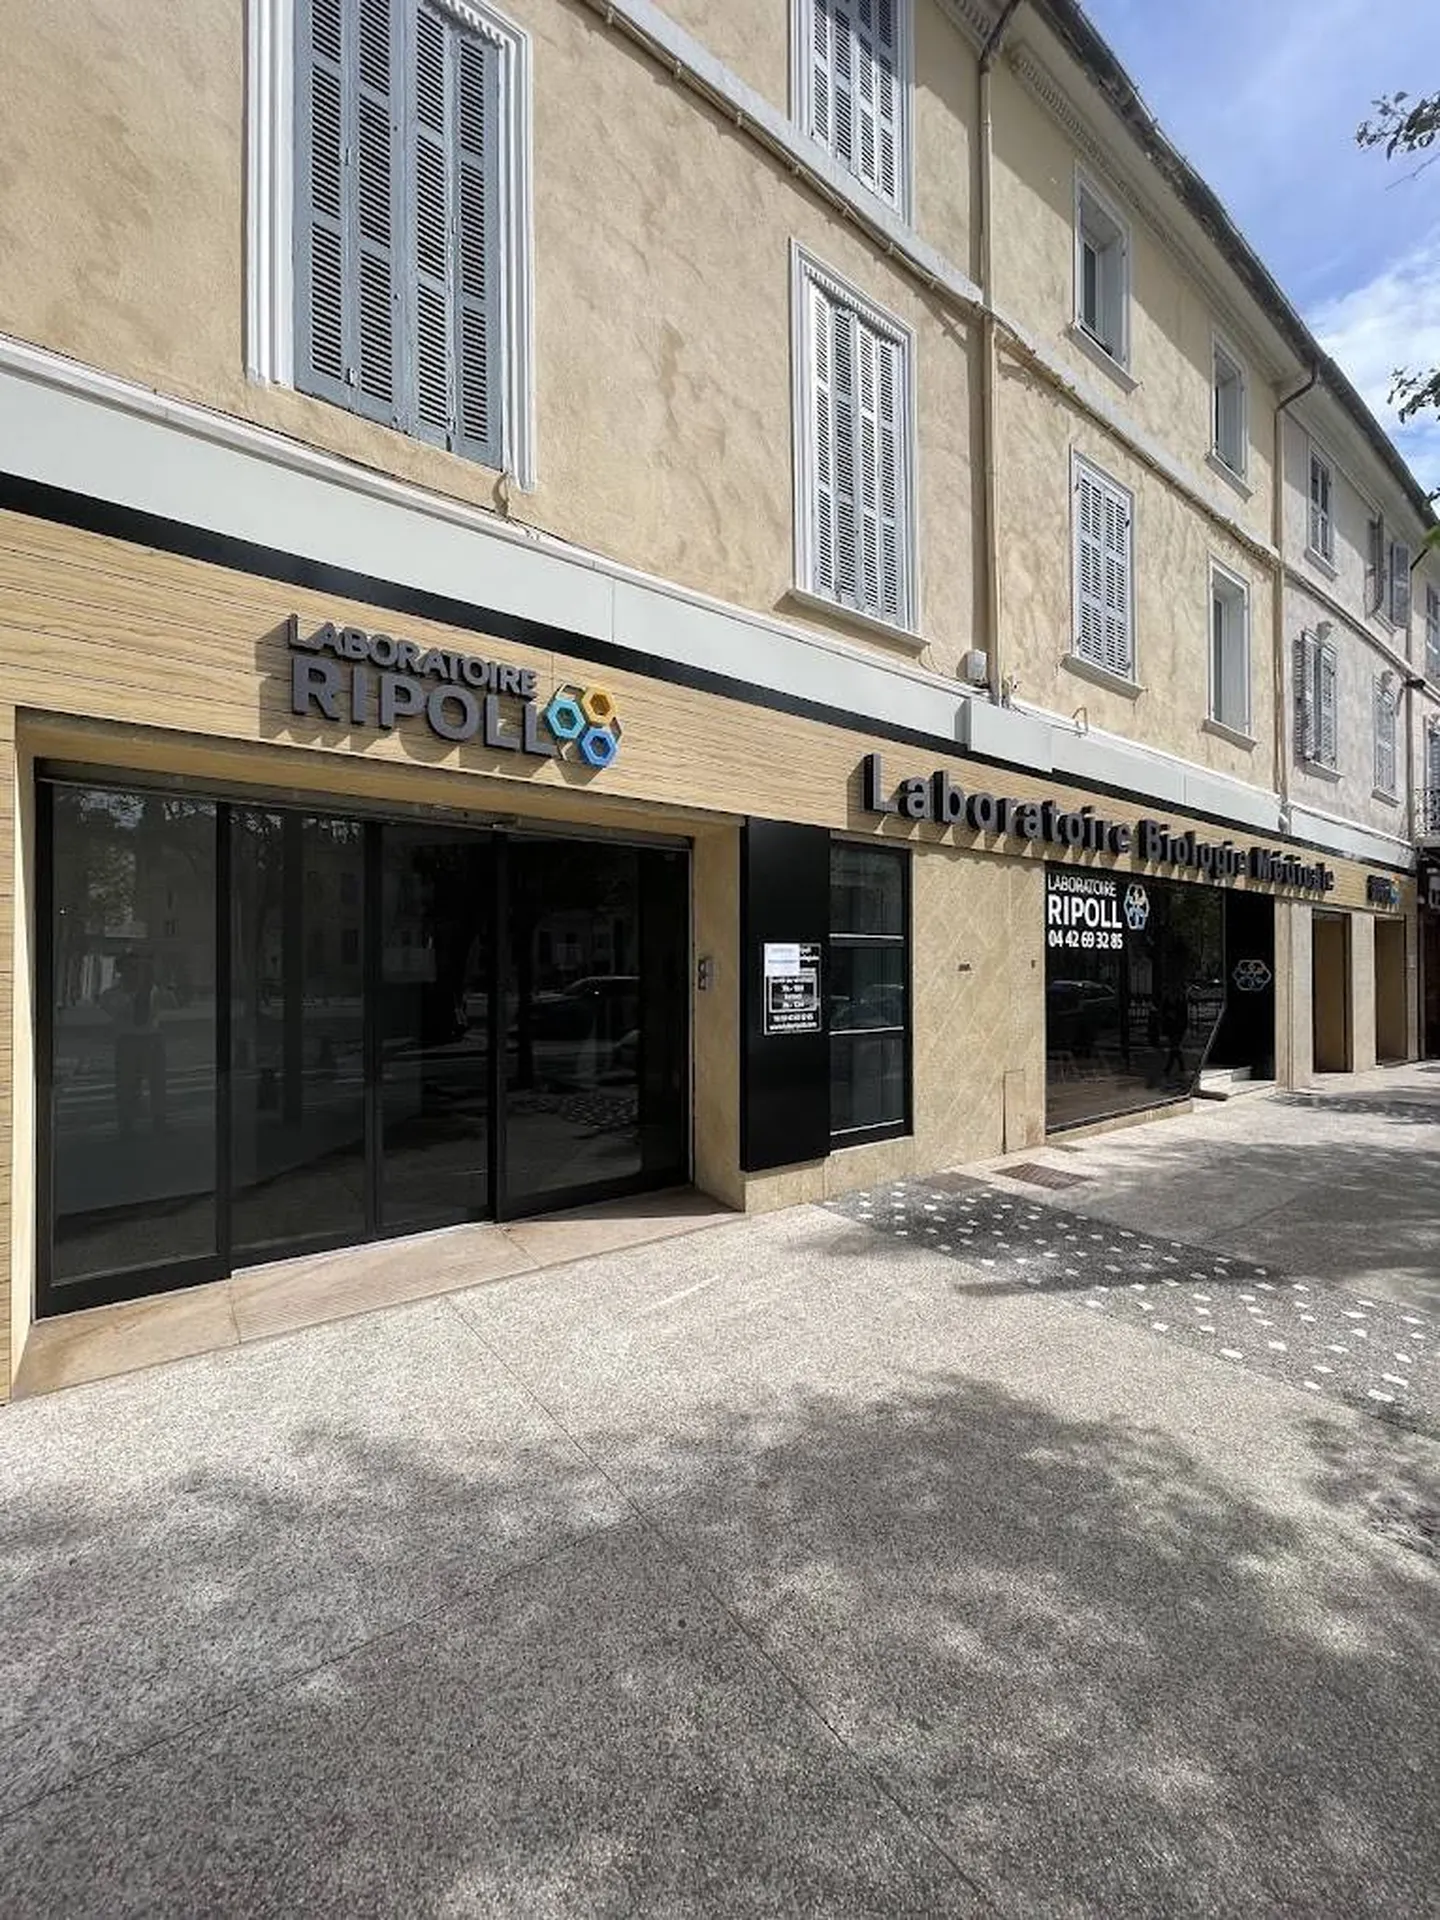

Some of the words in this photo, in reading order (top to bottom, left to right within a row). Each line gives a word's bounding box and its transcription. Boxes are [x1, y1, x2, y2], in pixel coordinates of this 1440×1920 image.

[288, 613, 537, 697] LABORATOIRE
[291, 656, 557, 756] RIPOLL
[863, 753, 1132, 854] Laboratoire
[1138, 819, 1249, 881] Biologie
[1048, 873, 1117, 897] LABORATOIRE
[1048, 894, 1123, 929] RIPOLL
[1048, 929, 1063, 948] 04
[1065, 930, 1079, 948] 42
[1081, 931, 1095, 948] 69
[1096, 932, 1109, 949] 32
[1110, 933, 1123, 949] 85
